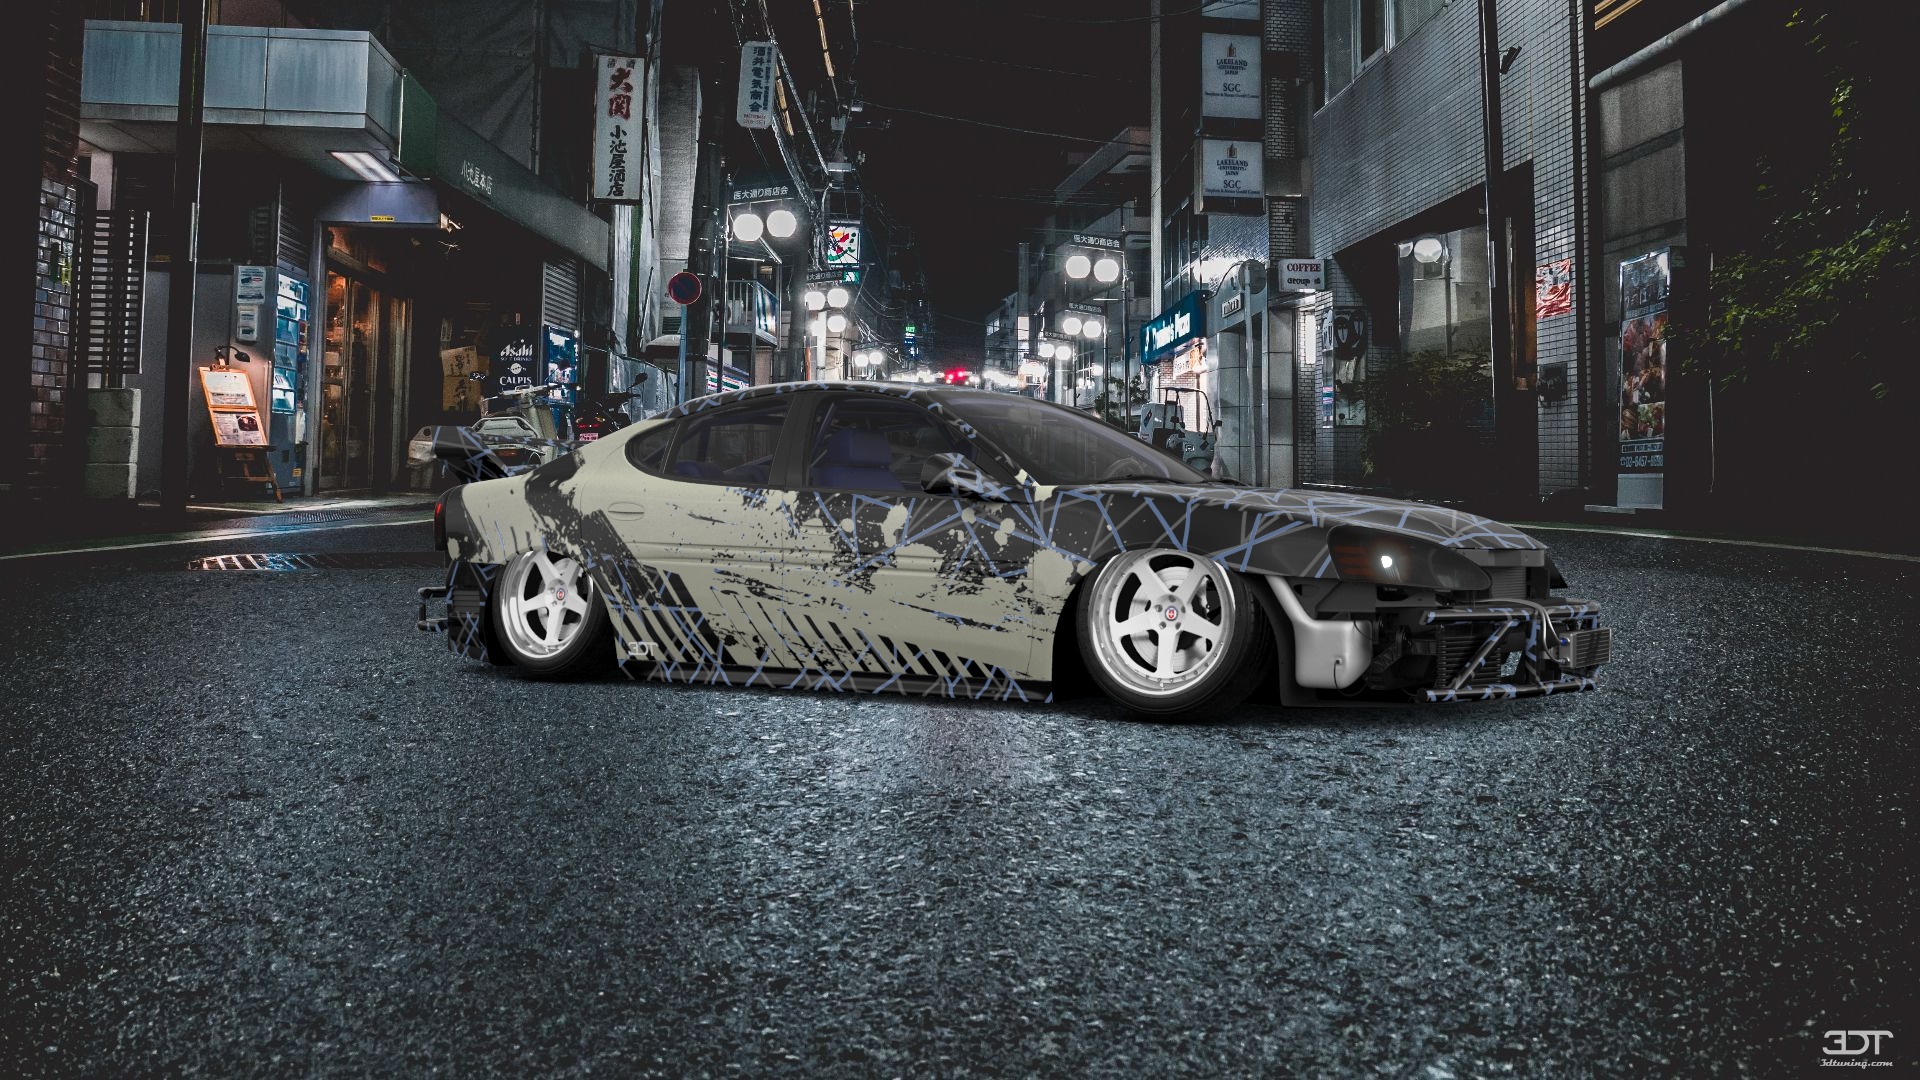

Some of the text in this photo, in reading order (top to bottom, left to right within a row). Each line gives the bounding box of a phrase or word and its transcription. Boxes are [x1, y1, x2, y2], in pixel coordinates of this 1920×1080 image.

[1216, 59, 1248, 68] LAKELAND
[1223, 83, 1241, 92] SGC
[607, 124, 628, 197] 小池屋酒店
[1216, 159, 1249, 168] LAKELAND
[1223, 179, 1241, 189] SGC
[733, 185, 789, 200] 医大通り商店会
[1286, 262, 1321, 272] COFFEE
[500, 338, 533, 357] Asahi
[499, 376, 532, 386] CALPIS
